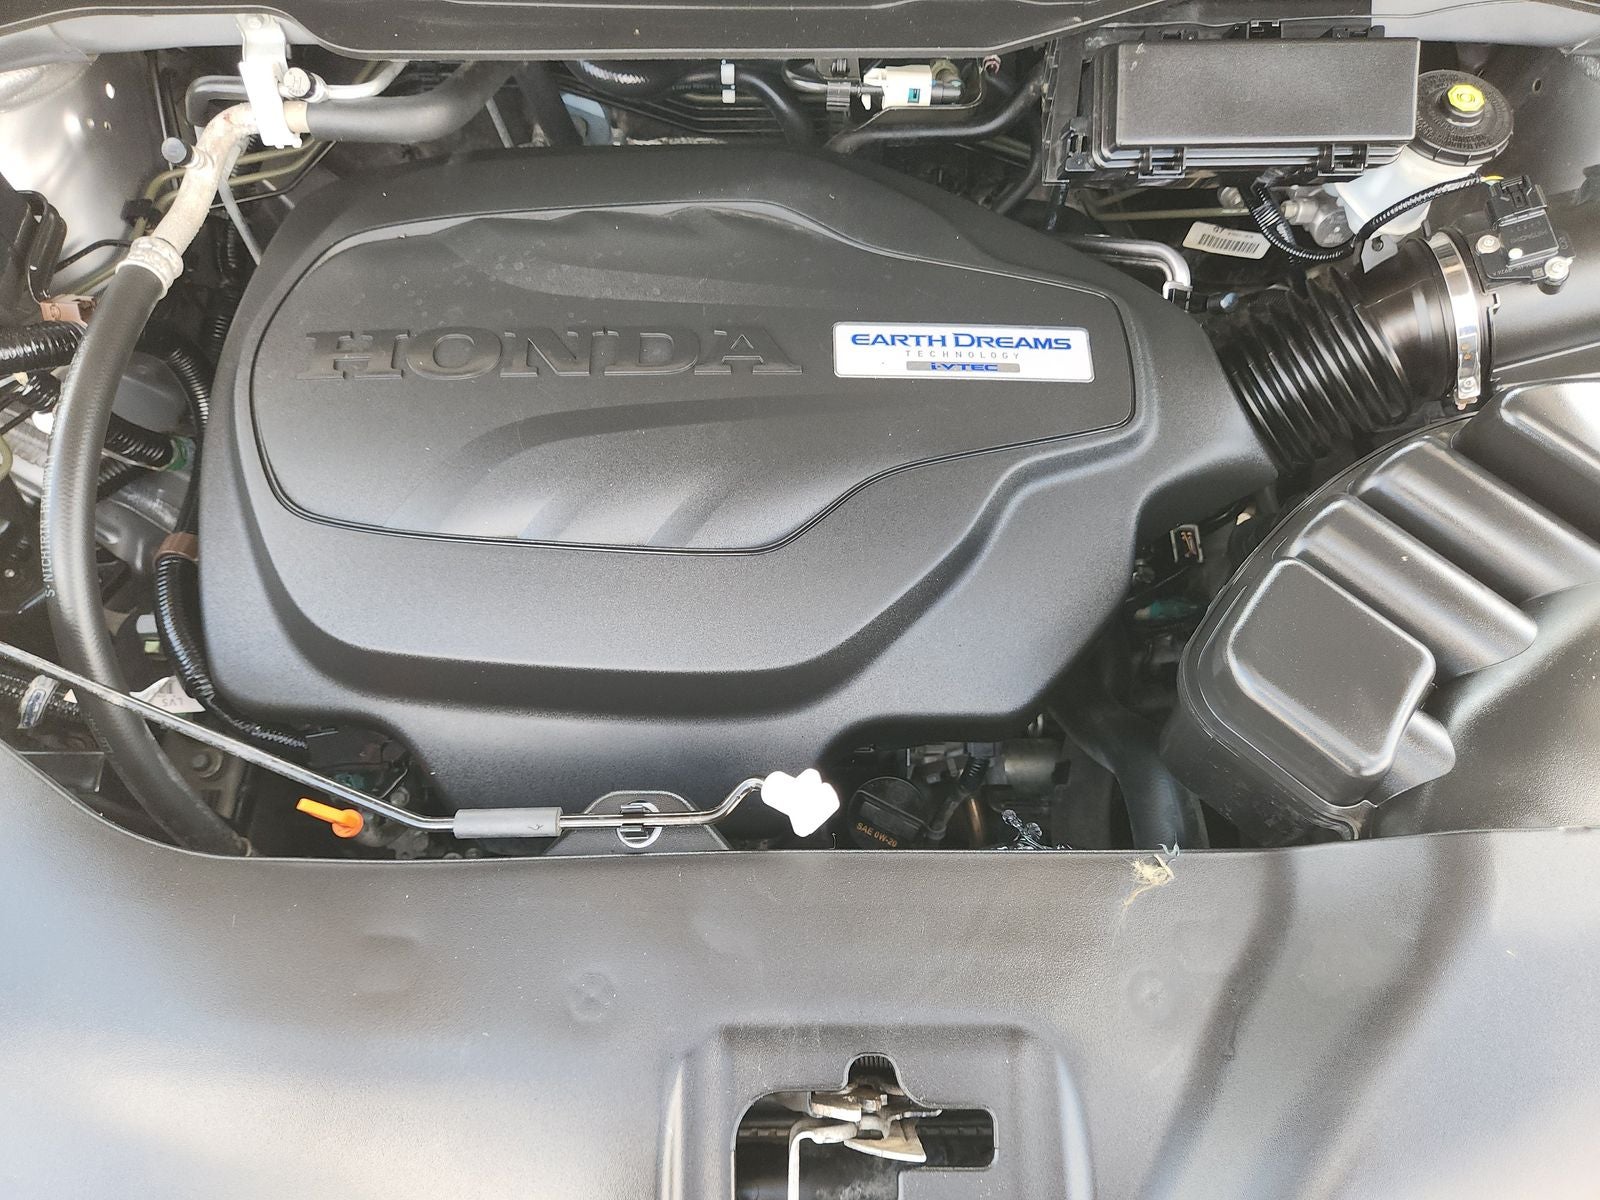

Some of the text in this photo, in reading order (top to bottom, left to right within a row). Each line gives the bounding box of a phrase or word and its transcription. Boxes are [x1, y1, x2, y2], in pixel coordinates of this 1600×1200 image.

[851, 332, 1072, 350] EARTH DREAMS
[298, 325, 803, 380] HONDA
[905, 350, 1020, 360] TECHNOLOGY
[930, 362, 998, 372] i-VTEC
[856, 822, 874, 837] SAE
